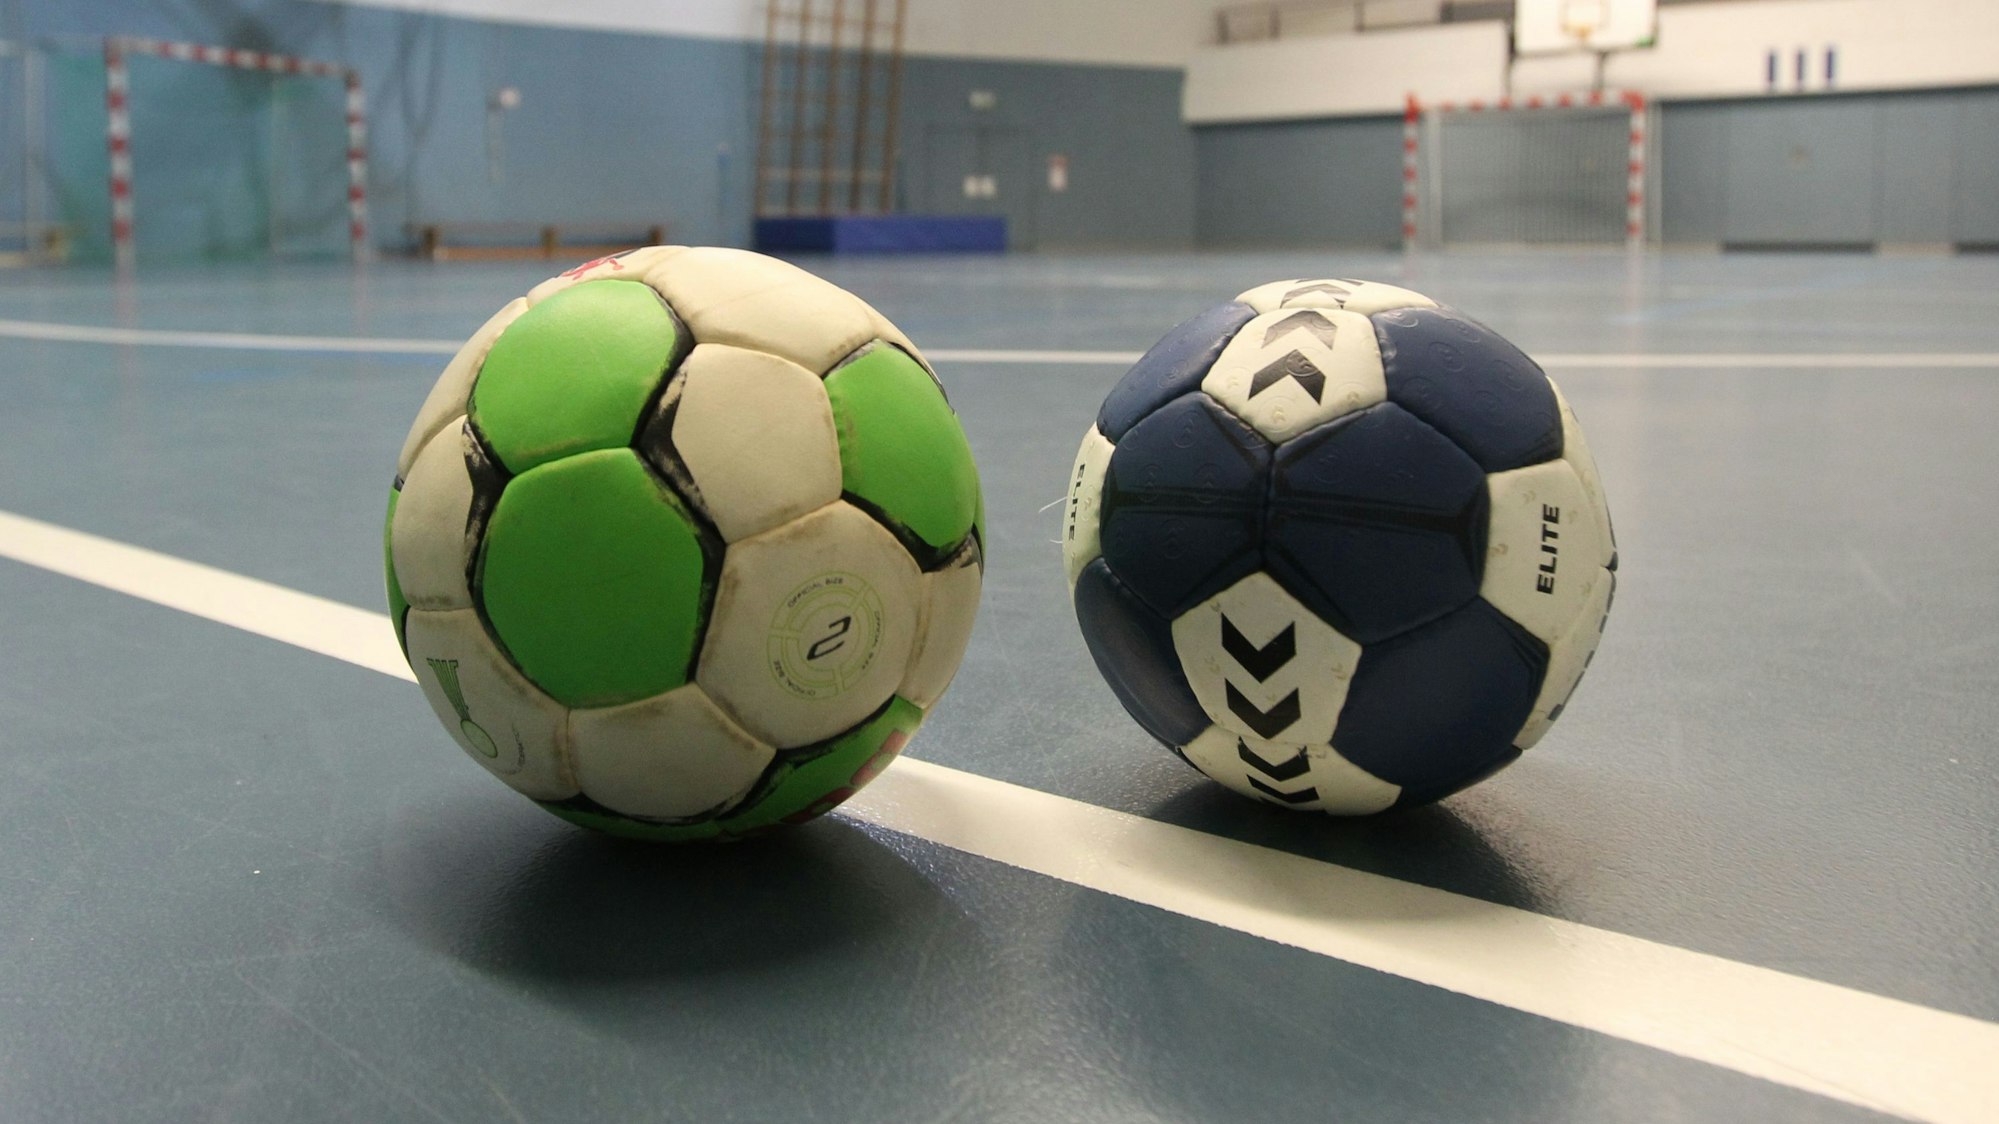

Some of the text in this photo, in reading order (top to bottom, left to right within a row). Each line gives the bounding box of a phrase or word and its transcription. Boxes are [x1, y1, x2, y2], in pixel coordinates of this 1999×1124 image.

[1069, 464, 1086, 541] ELITE
[1536, 503, 1560, 595] ELITE
[787, 577, 844, 608] OFFICIAL SIZE
[806, 614, 852, 661] 2
